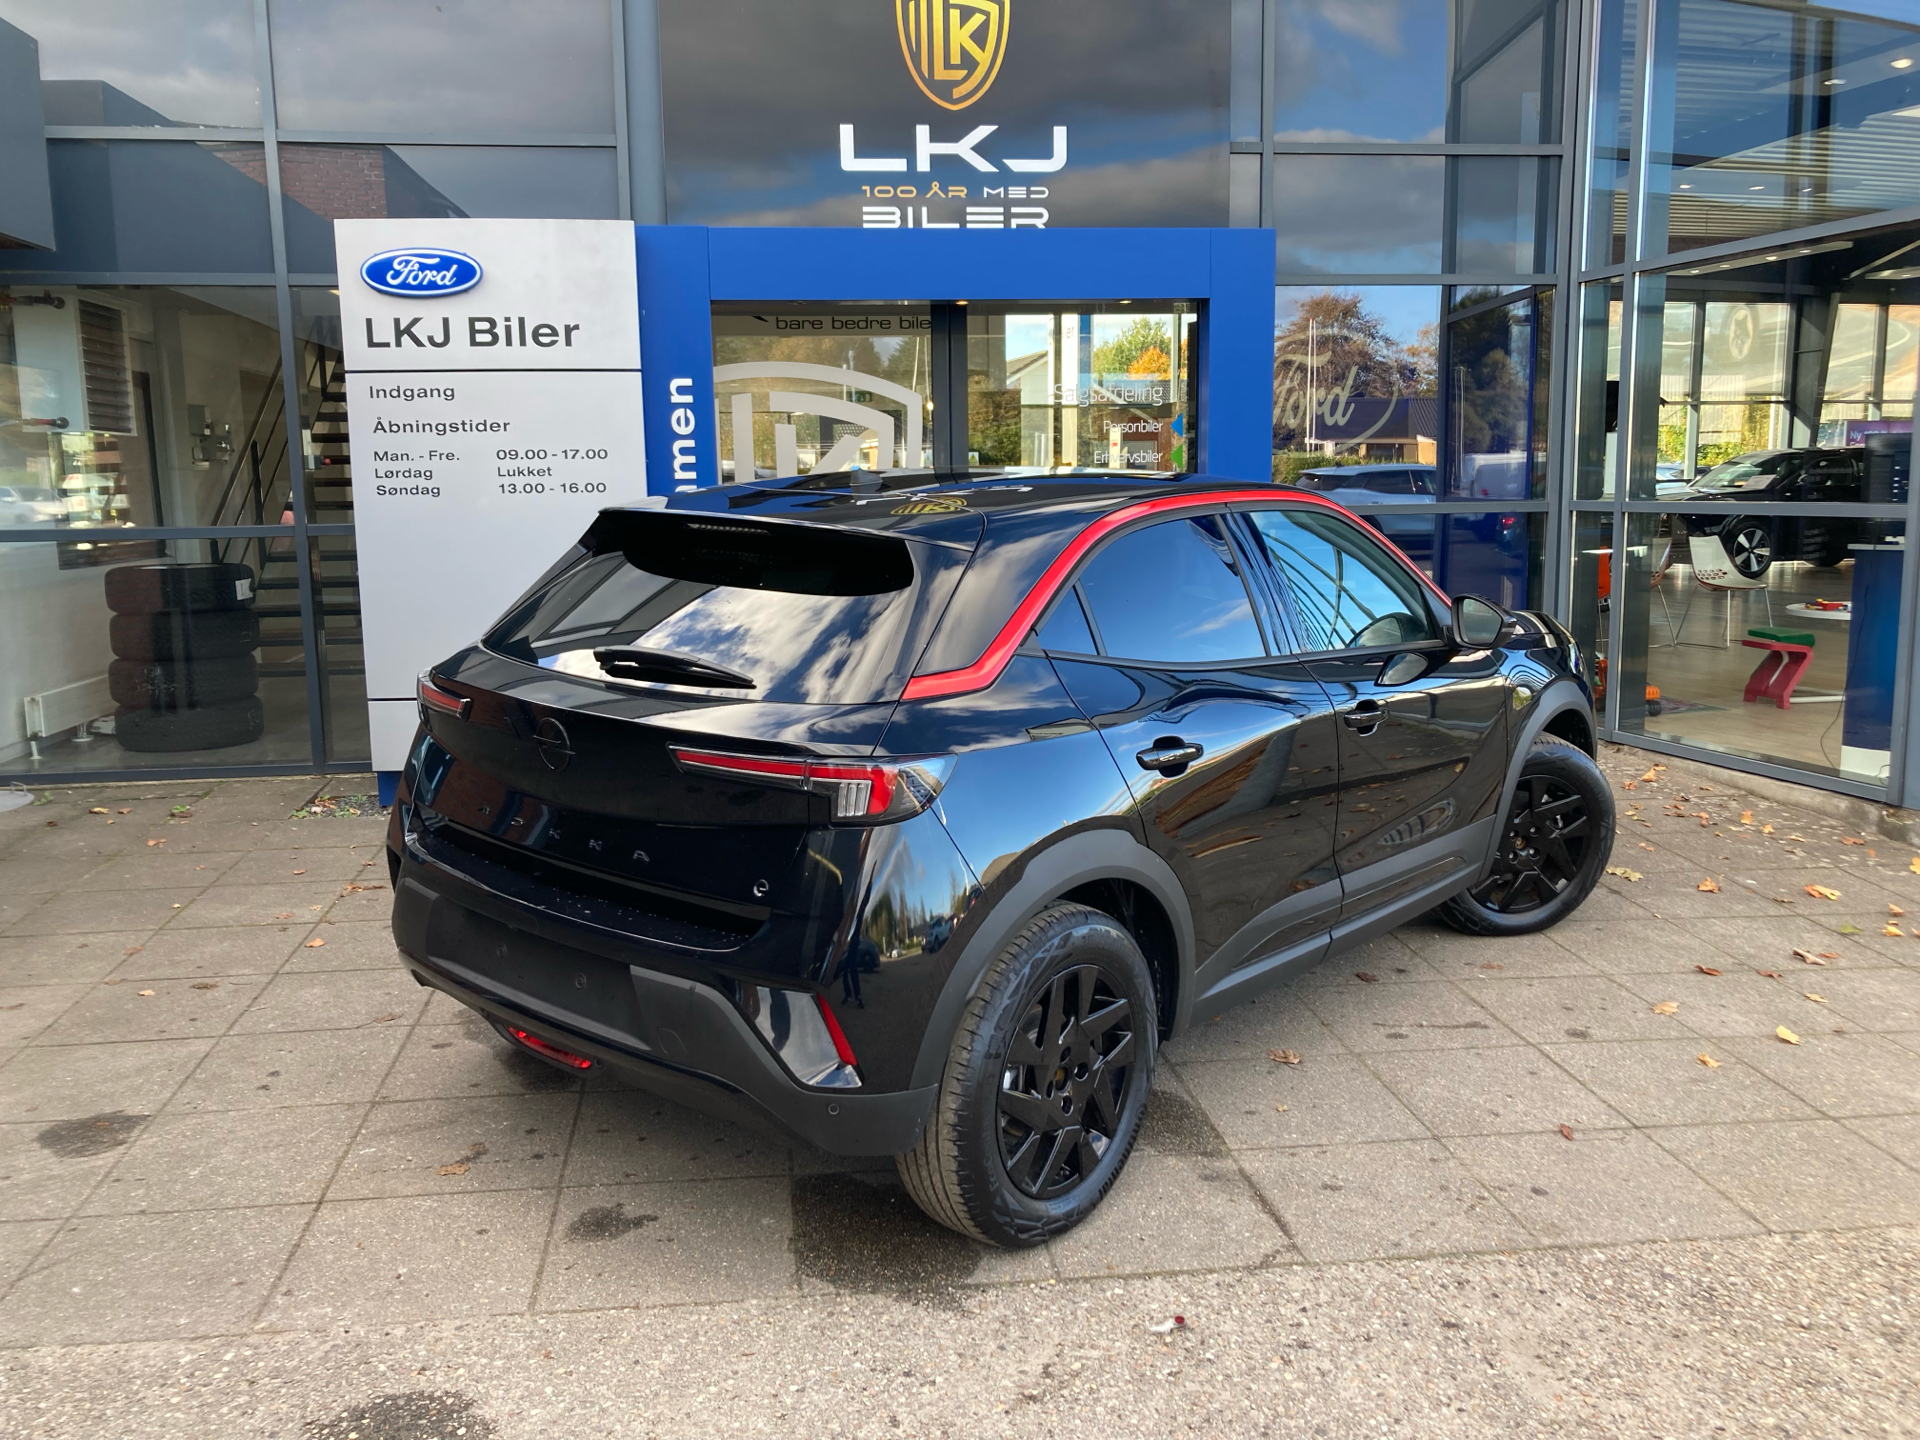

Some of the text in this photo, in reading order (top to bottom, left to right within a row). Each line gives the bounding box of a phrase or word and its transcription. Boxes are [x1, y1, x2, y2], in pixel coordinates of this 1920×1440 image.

[839, 123, 1068, 172] LKJ
[861, 181, 1050, 198] 100 ÅR MED
[862, 206, 1050, 229] BILER
[386, 255, 458, 286] Ford
[365, 315, 580, 348] LKJ Biler
[776, 316, 932, 330] bare bedre bile
[369, 385, 455, 402] Indgang
[1053, 383, 1164, 408] Salgsafdeling
[1273, 350, 1358, 428] Ford
[372, 416, 511, 436] Åbningstider
[1103, 420, 1164, 434] Personbiler
[373, 450, 415, 462] Man.
[428, 450, 460, 461] Fre.
[496, 449, 548, 460] 09.00
[561, 448, 608, 460] 17.00
[1093, 449, 1164, 464] Erhvervsbiler
[374, 466, 553, 481] Lørdag Lukket
[376, 484, 441, 498] Søndag
[499, 483, 545, 494] 13.00
[560, 482, 607, 494] 16.00
